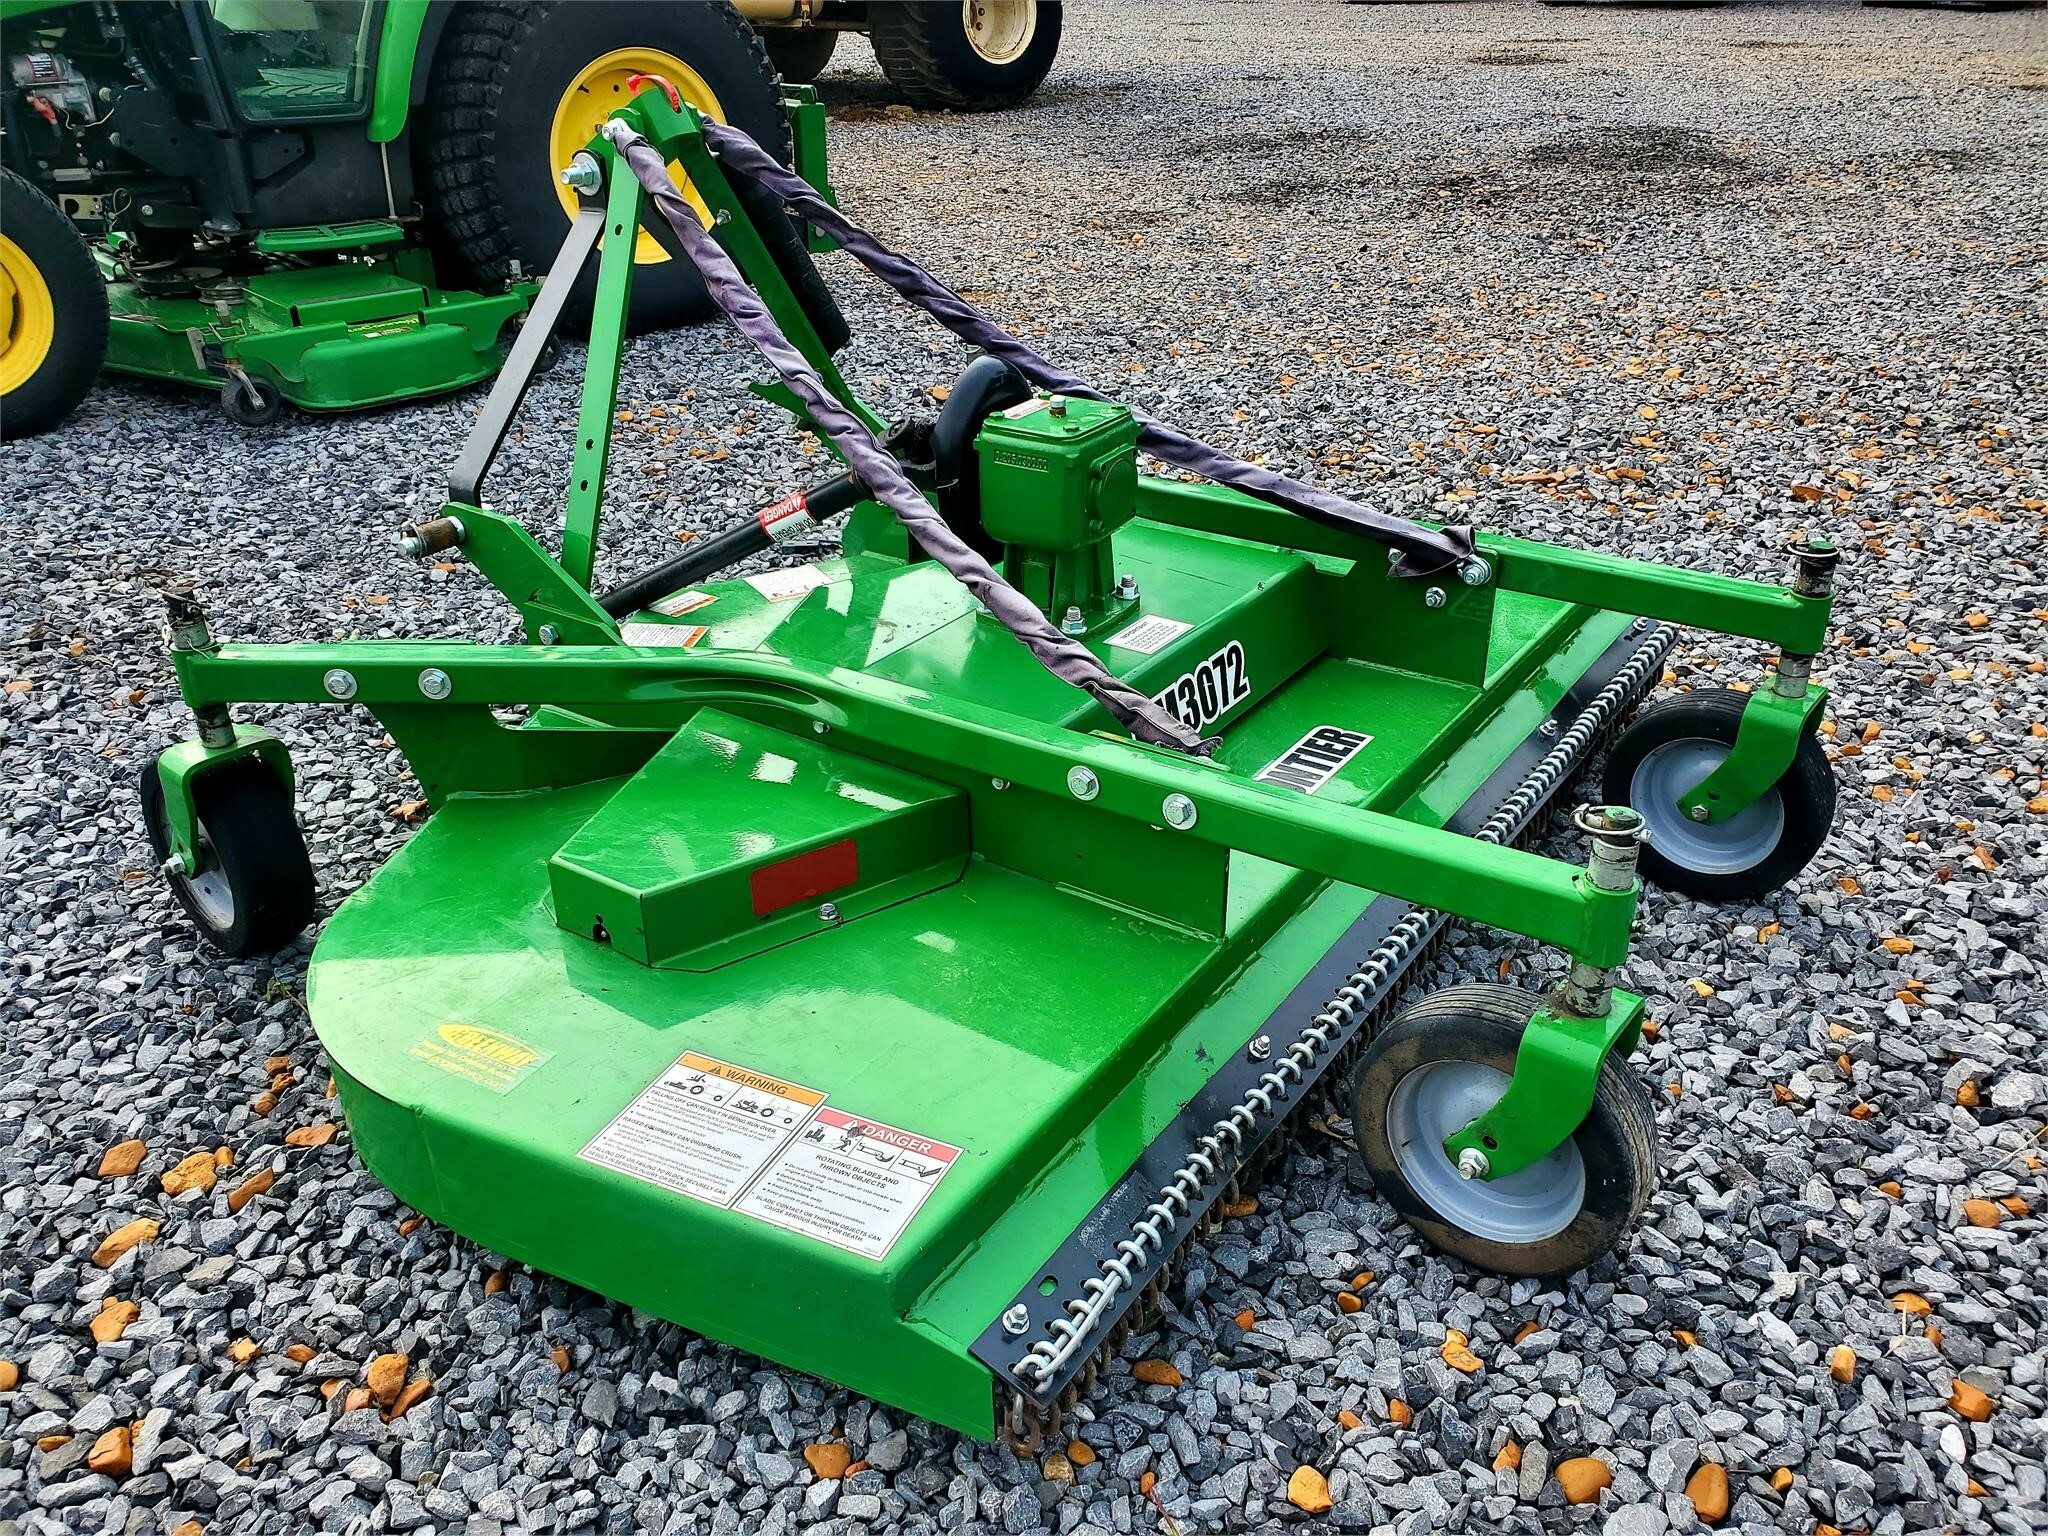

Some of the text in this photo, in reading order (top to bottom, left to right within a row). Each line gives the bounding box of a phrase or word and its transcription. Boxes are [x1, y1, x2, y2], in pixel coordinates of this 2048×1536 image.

[764, 500, 794, 522] DANGER
[1259, 728, 1367, 794] NTIER
[726, 1070, 788, 1094] WARNING
[650, 1089, 674, 1100] FALLING
[686, 1100, 699, 1108] CAN
[698, 1104, 721, 1115] RESULT
[727, 1114, 746, 1124] BEING
[746, 1120, 760, 1128] RUN
[760, 1124, 778, 1134] OVER.
[622, 1116, 644, 1126] RAISED
[643, 1123, 677, 1138] EQUIPMENT
[676, 1134, 690, 1142] CAN
[689, 1138, 707, 1148] DROP
[706, 1144, 721, 1152] AND
[861, 1125, 933, 1153] DANGER
[586, 1150, 607, 1160] RESULT
[614, 1159, 638, 1171] SERIOUS
[638, 1167, 657, 1177] INJURY
[667, 1178, 689, 1188] DEATH.
[591, 1145, 614, 1156] FALLING
[635, 1160, 656, 1170] FAILING
[665, 1170, 684, 1180] BLOCK
[685, 1177, 714, 1190] SECURELY
[714, 1187, 726, 1195] CAN
[815, 1154, 899, 1185] ROTATING BLADES AND
[818, 1163, 886, 1188] THROWN OBJECTS
[755, 1194, 775, 1204] BLADE
[775, 1201, 802, 1214] CONTACT
[813, 1214, 839, 1227] THROWN
[839, 1223, 867, 1237] OBJECTS
[868, 1233, 881, 1241] CAN
[764, 1204, 784, 1214] CAUSE
[784, 1211, 810, 1223] SERIOUS
[810, 1220, 831, 1231] INJURY
